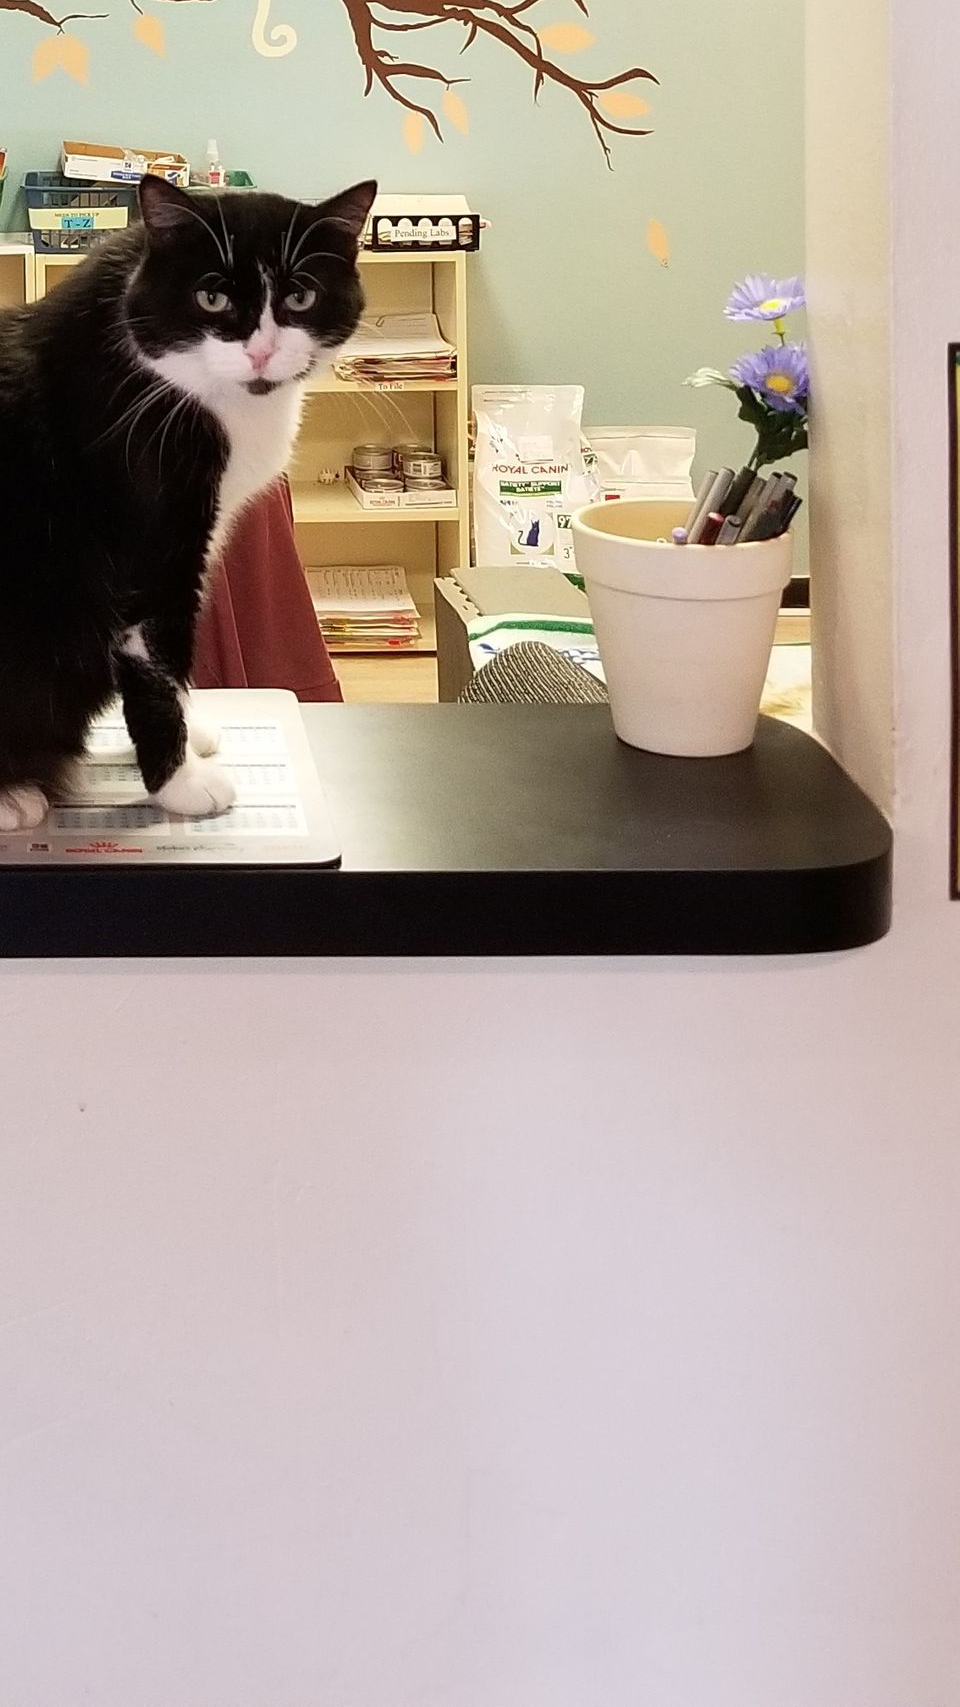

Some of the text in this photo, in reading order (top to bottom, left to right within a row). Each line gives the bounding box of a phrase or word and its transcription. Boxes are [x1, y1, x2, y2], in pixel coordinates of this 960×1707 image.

[394, 228, 450, 238] Pending Labs
[531, 463, 569, 474] CANIN
